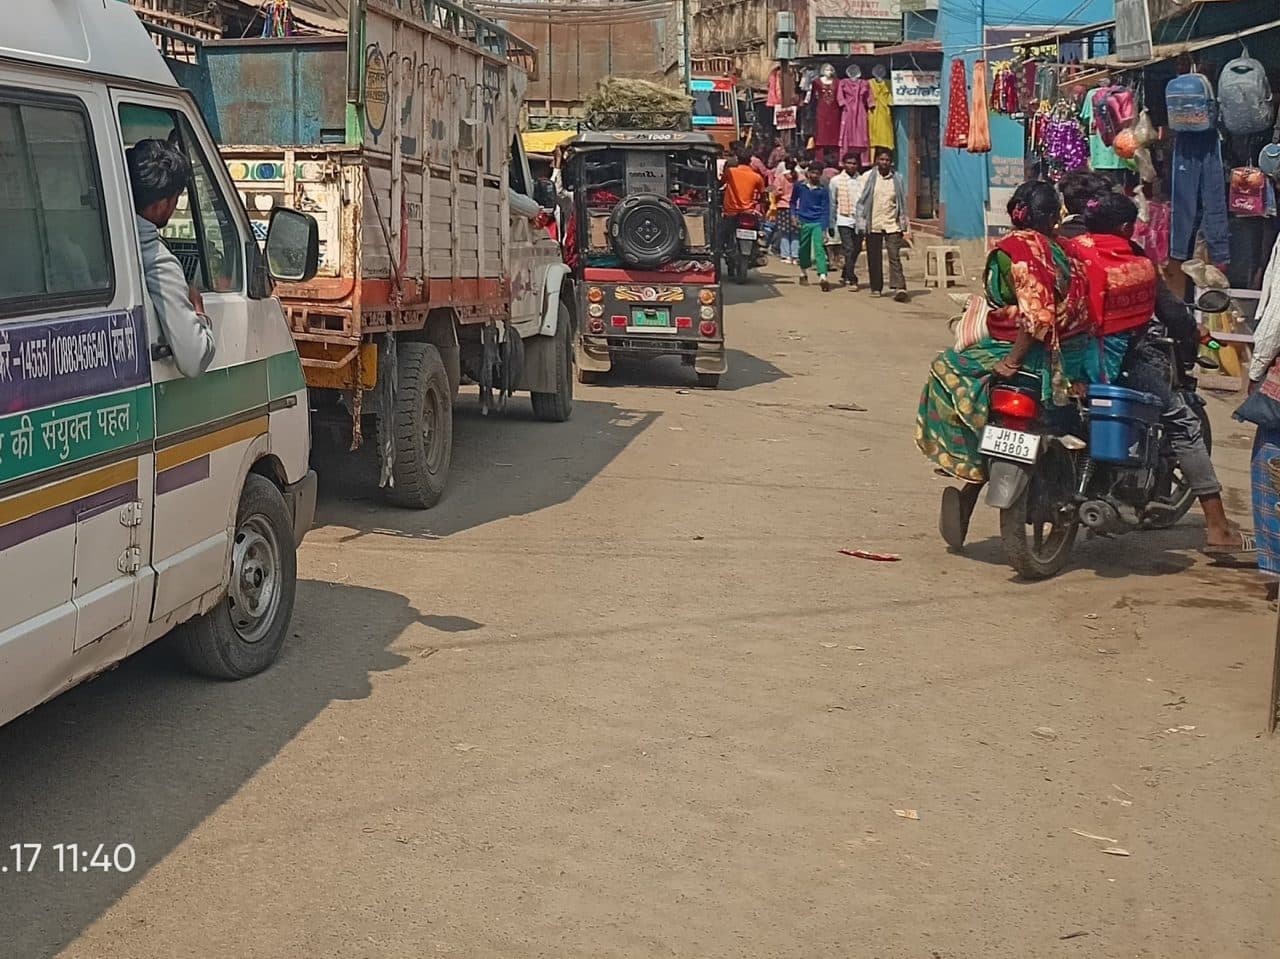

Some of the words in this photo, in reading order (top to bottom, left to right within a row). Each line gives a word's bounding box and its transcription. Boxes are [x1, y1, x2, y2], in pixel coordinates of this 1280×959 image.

[10, 414, 34, 459] की
[41, 410, 92, 459] संयुक्त
[96, 402, 130, 437] पहल
[997, 430, 1024, 444] JH16
[994, 440, 1030, 456] H3803
